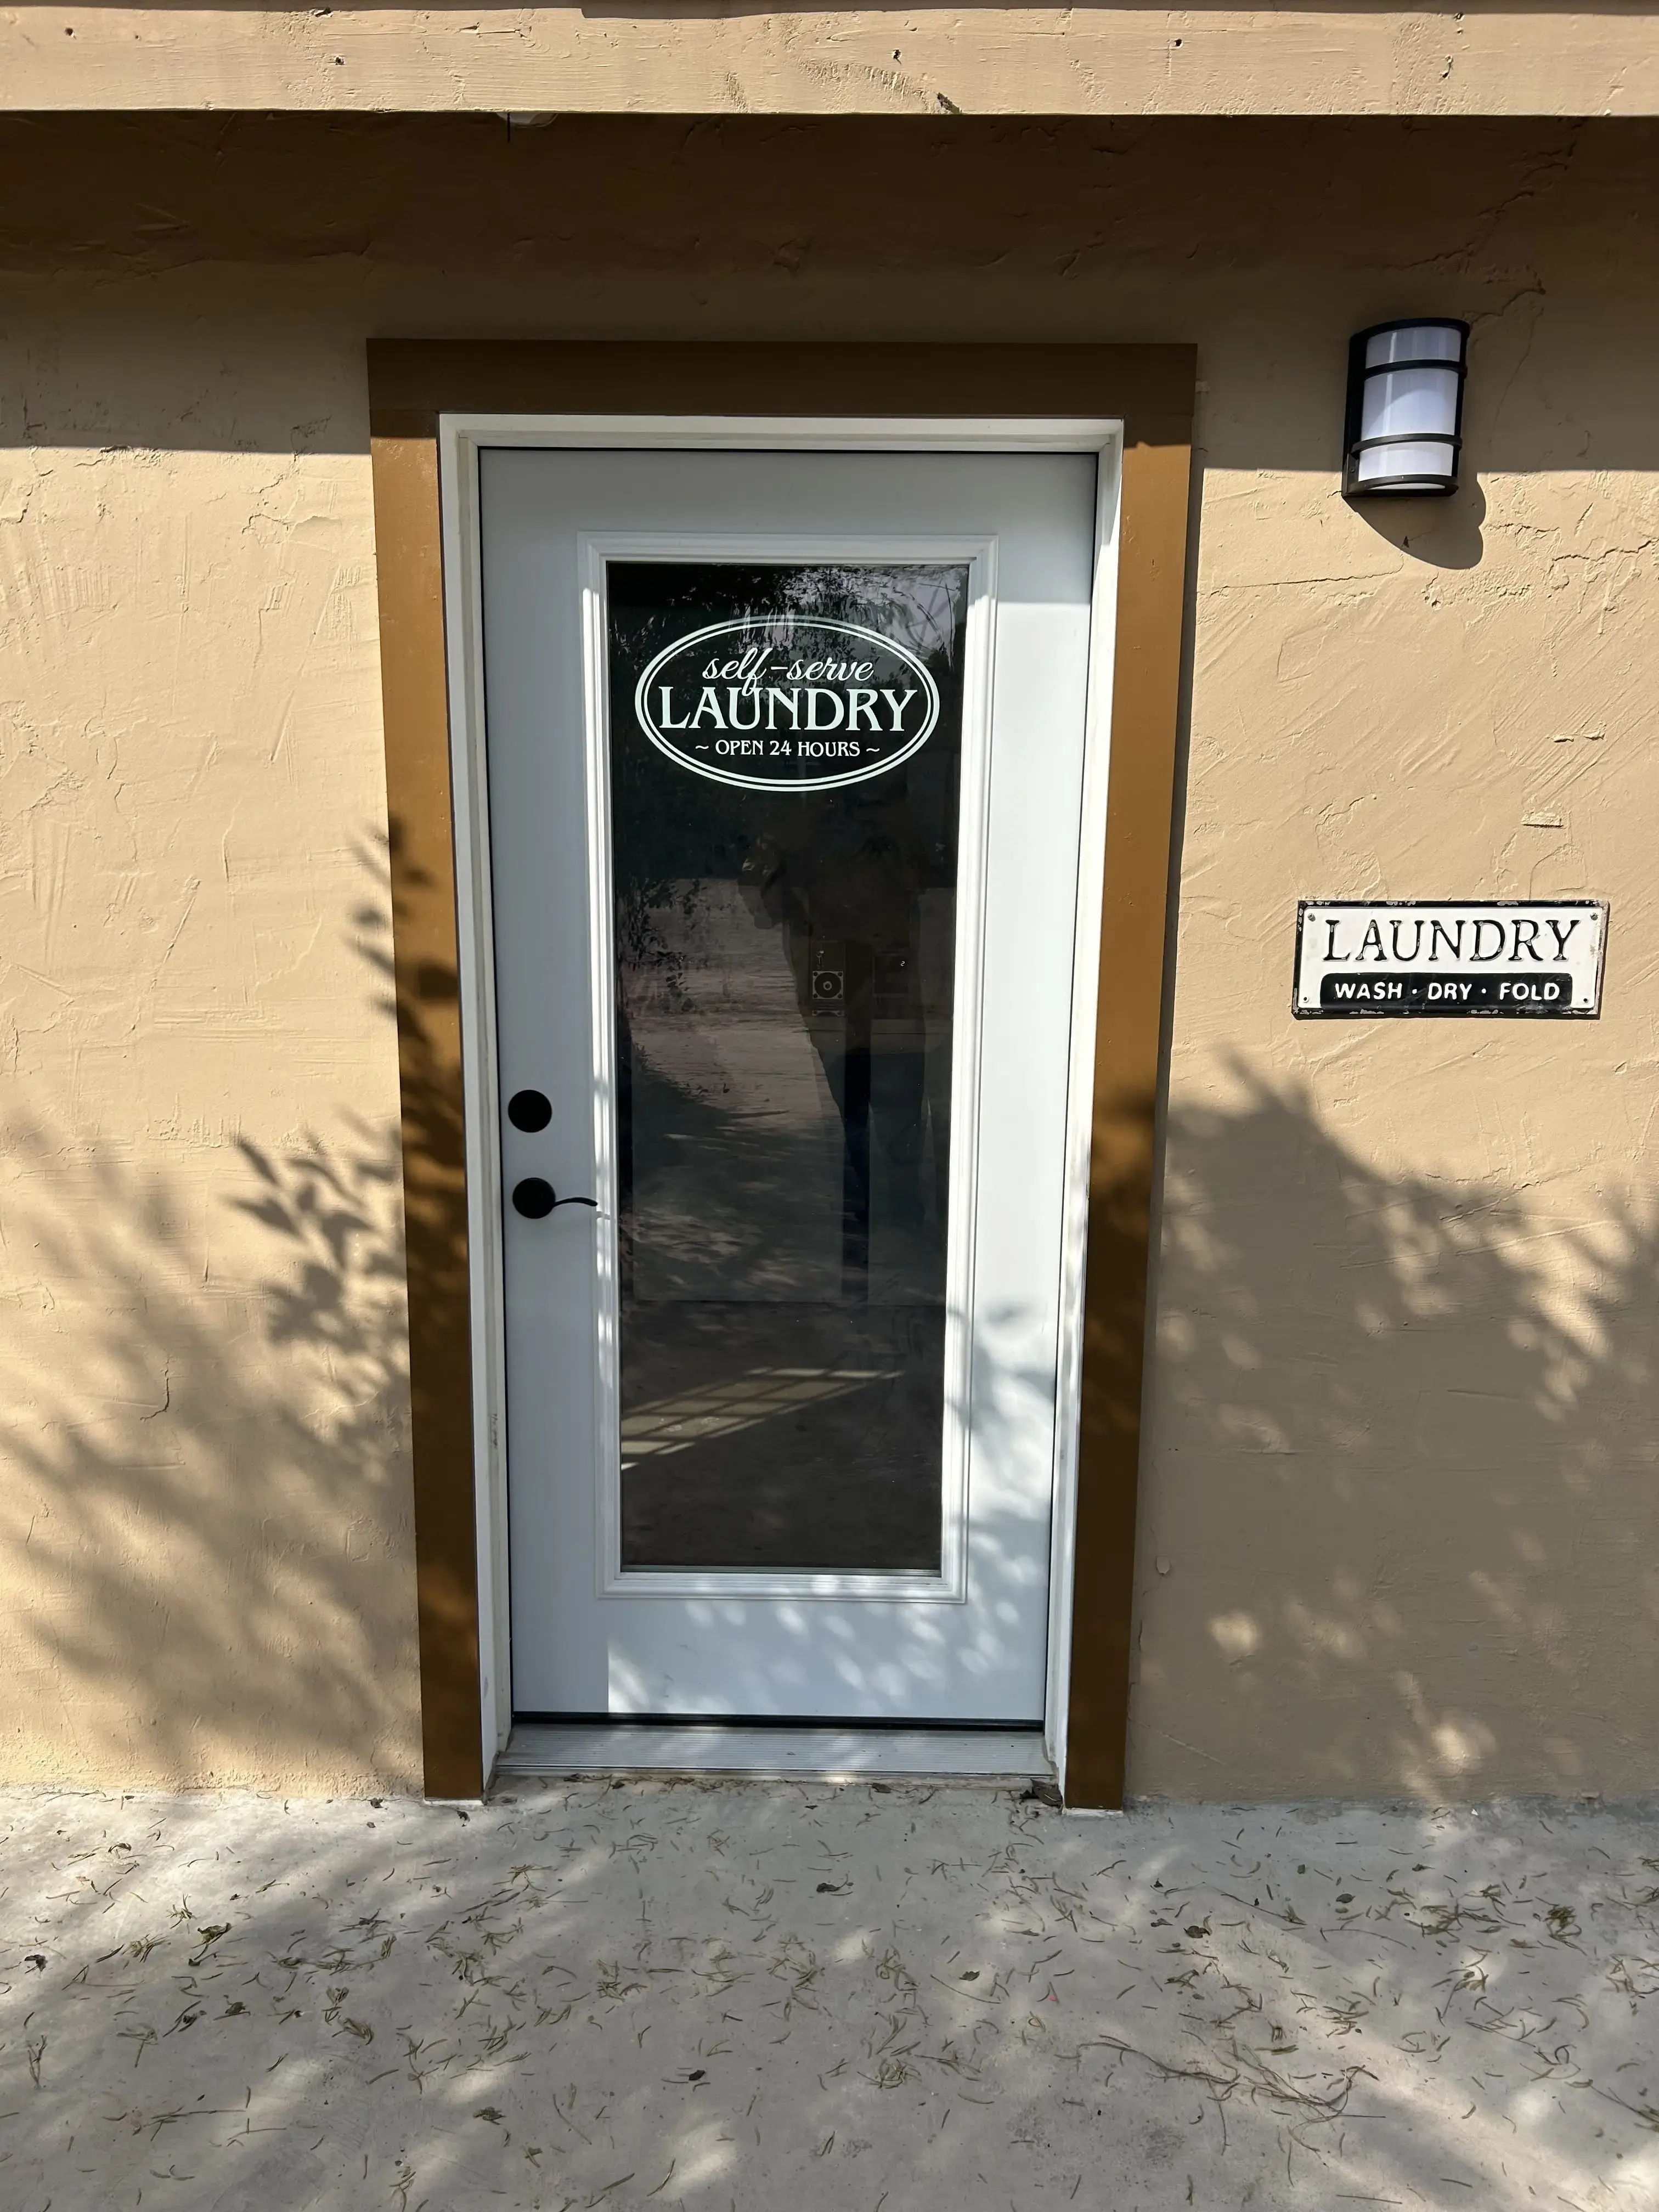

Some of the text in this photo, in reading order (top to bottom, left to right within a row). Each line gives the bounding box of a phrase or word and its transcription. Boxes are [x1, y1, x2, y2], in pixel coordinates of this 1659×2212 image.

[702, 647, 874, 697] self-serve
[658, 686, 918, 731] LAUNDRY
[715, 740, 860, 757] OPEN 24 HOURS
[1323, 919, 1580, 961] LAUNDRY
[1335, 983, 1560, 1000] WASH DRY FOLD
